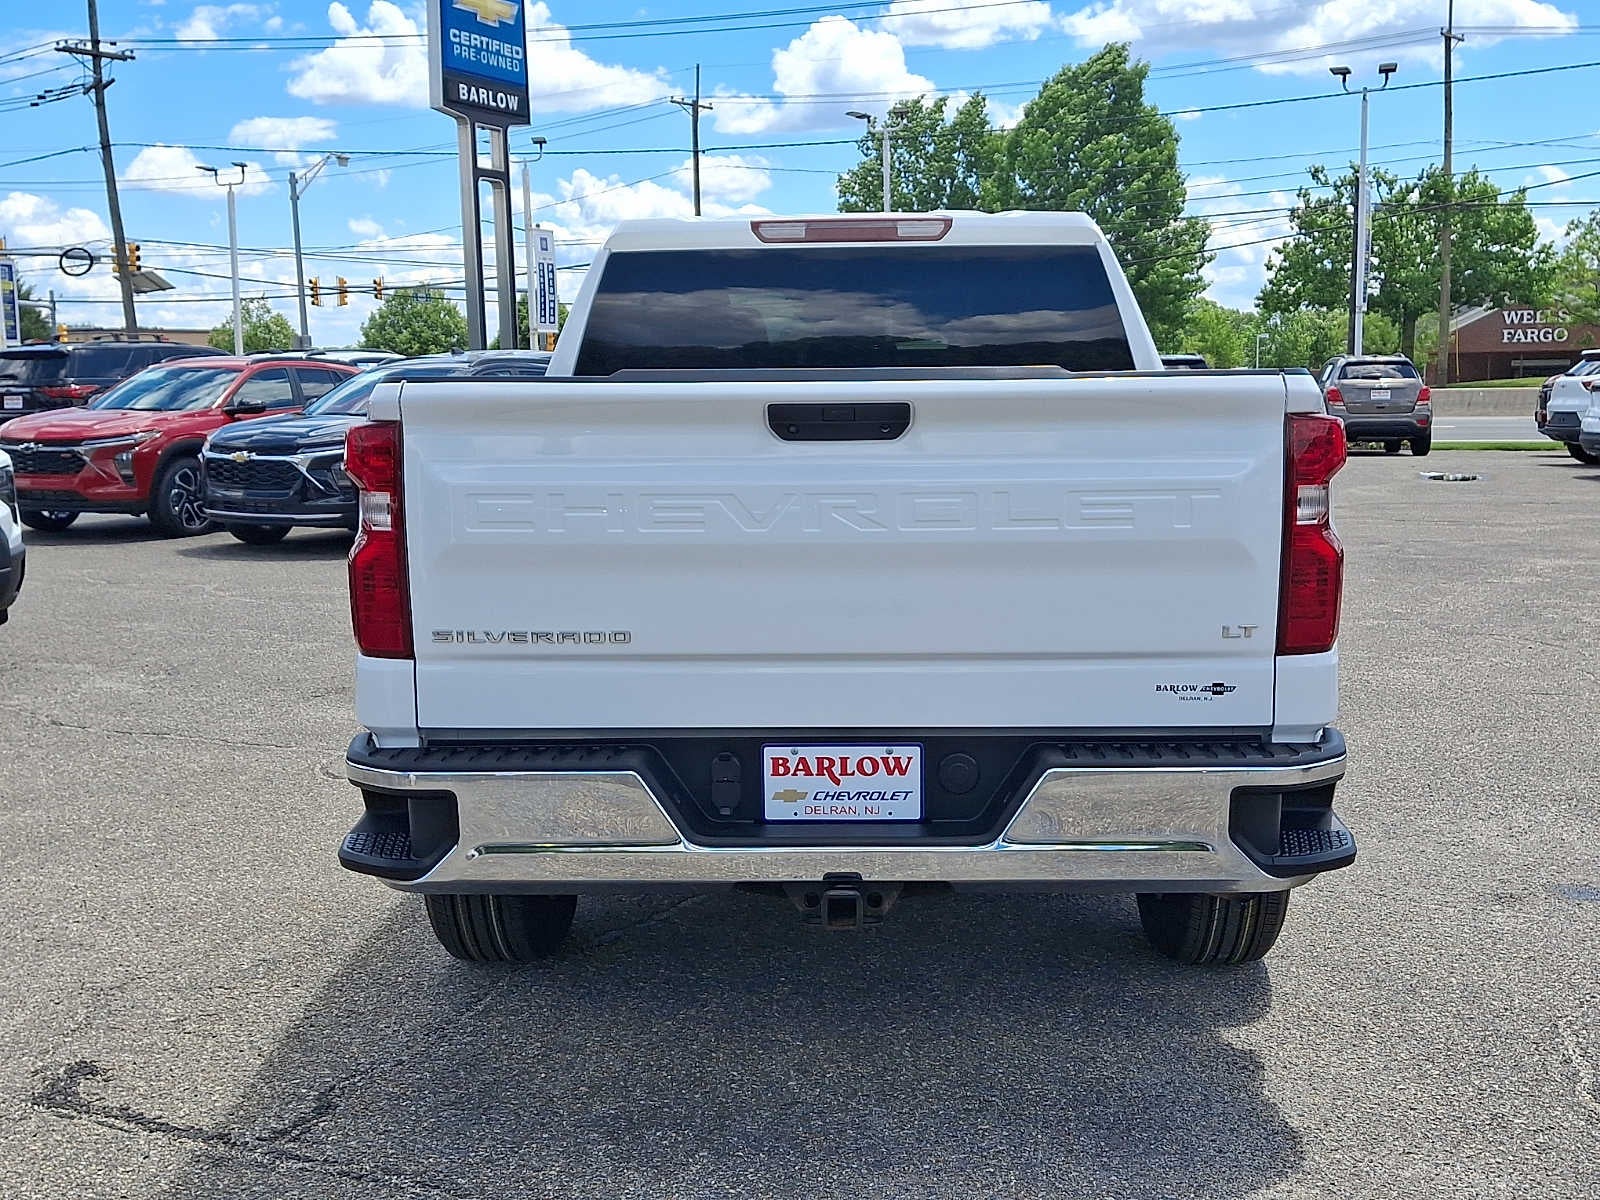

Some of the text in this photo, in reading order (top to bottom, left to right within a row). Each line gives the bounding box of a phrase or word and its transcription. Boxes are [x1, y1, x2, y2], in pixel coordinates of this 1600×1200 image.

[449, 28, 522, 59] CERTIFIED
[453, 44, 520, 72] PRE-OWNED
[458, 83, 519, 111] BARLOW
[1502, 328, 1569, 343] FARGO
[464, 489, 1222, 533] CHEVROLET
[432, 630, 632, 644] SILVERADO
[1221, 624, 1258, 639] LT
[1155, 684, 1198, 695] BARLOW
[770, 756, 913, 786] BARLOW
[812, 790, 914, 801] CHEVROLET
[804, 806, 880, 816] DELRAN, NJ
